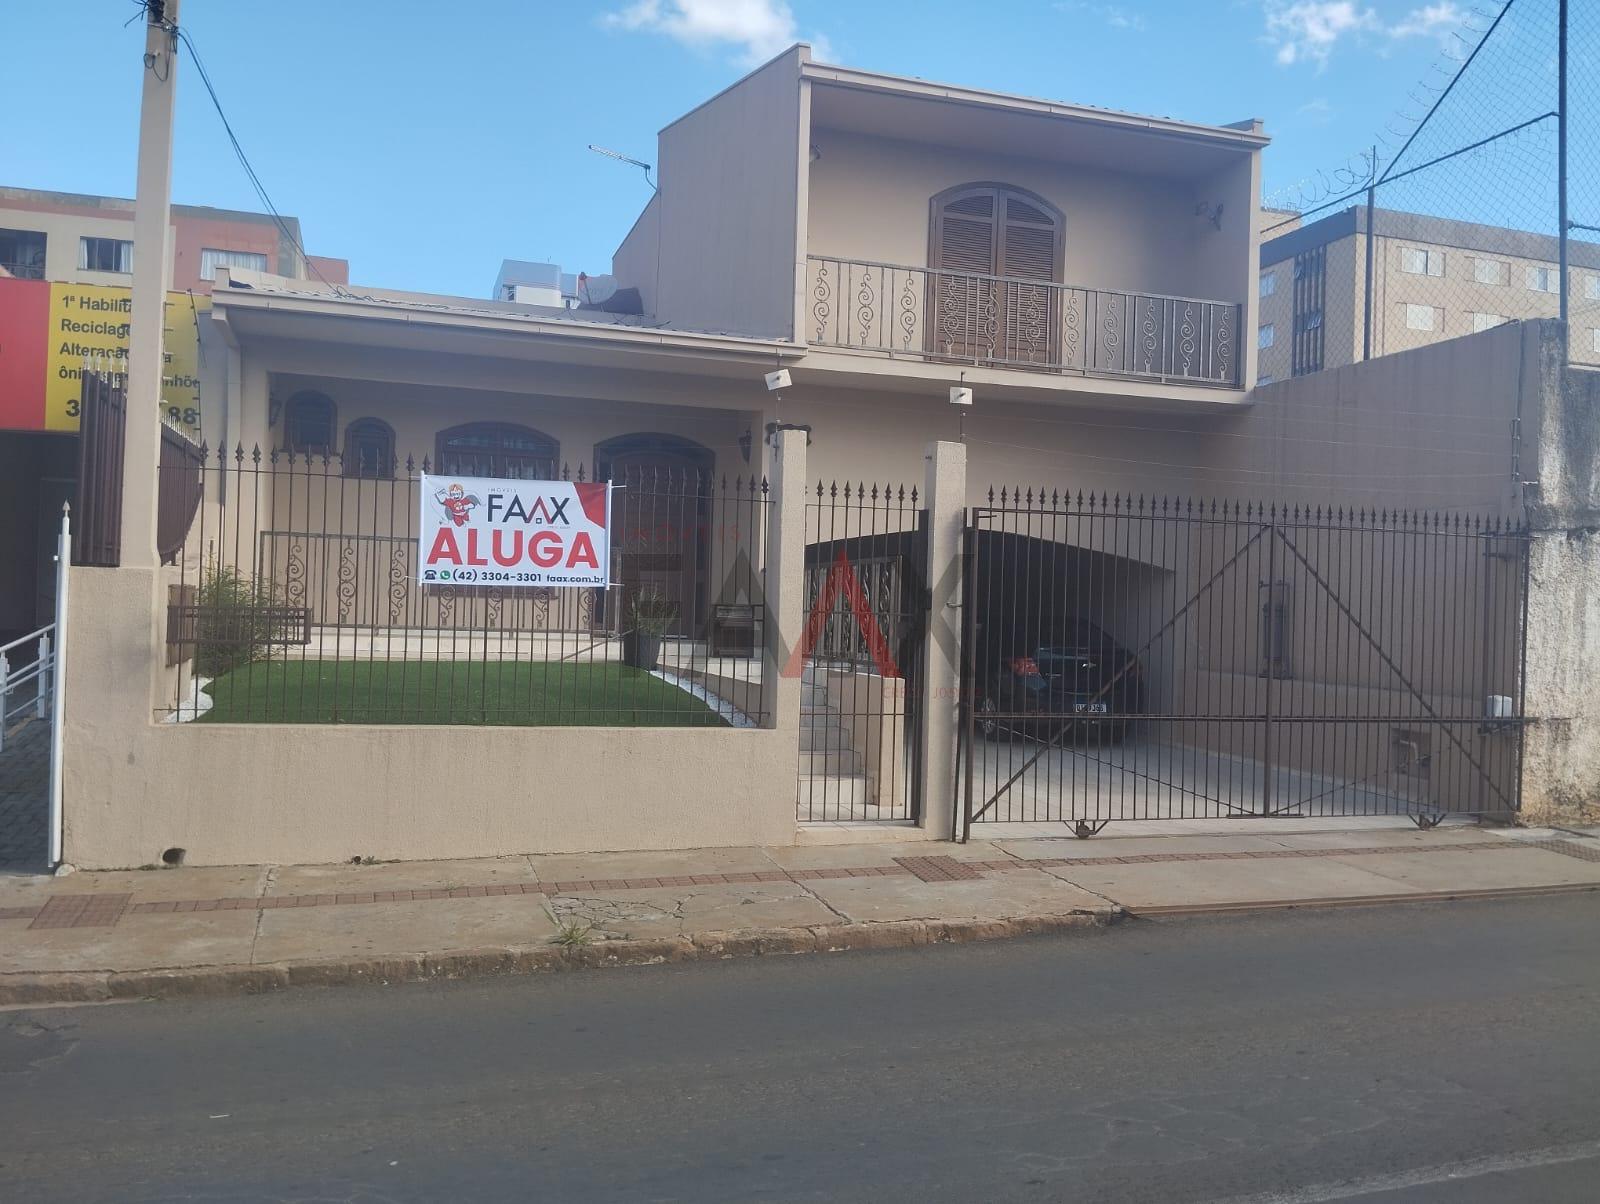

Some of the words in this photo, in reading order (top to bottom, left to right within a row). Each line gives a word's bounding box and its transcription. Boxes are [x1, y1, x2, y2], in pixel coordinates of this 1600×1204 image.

[426, 527, 599, 569] ALUGA
[452, 568, 478, 582] (42)
[481, 571, 541, 583] 3304-3301
[546, 574, 604, 584] faax.com.br
